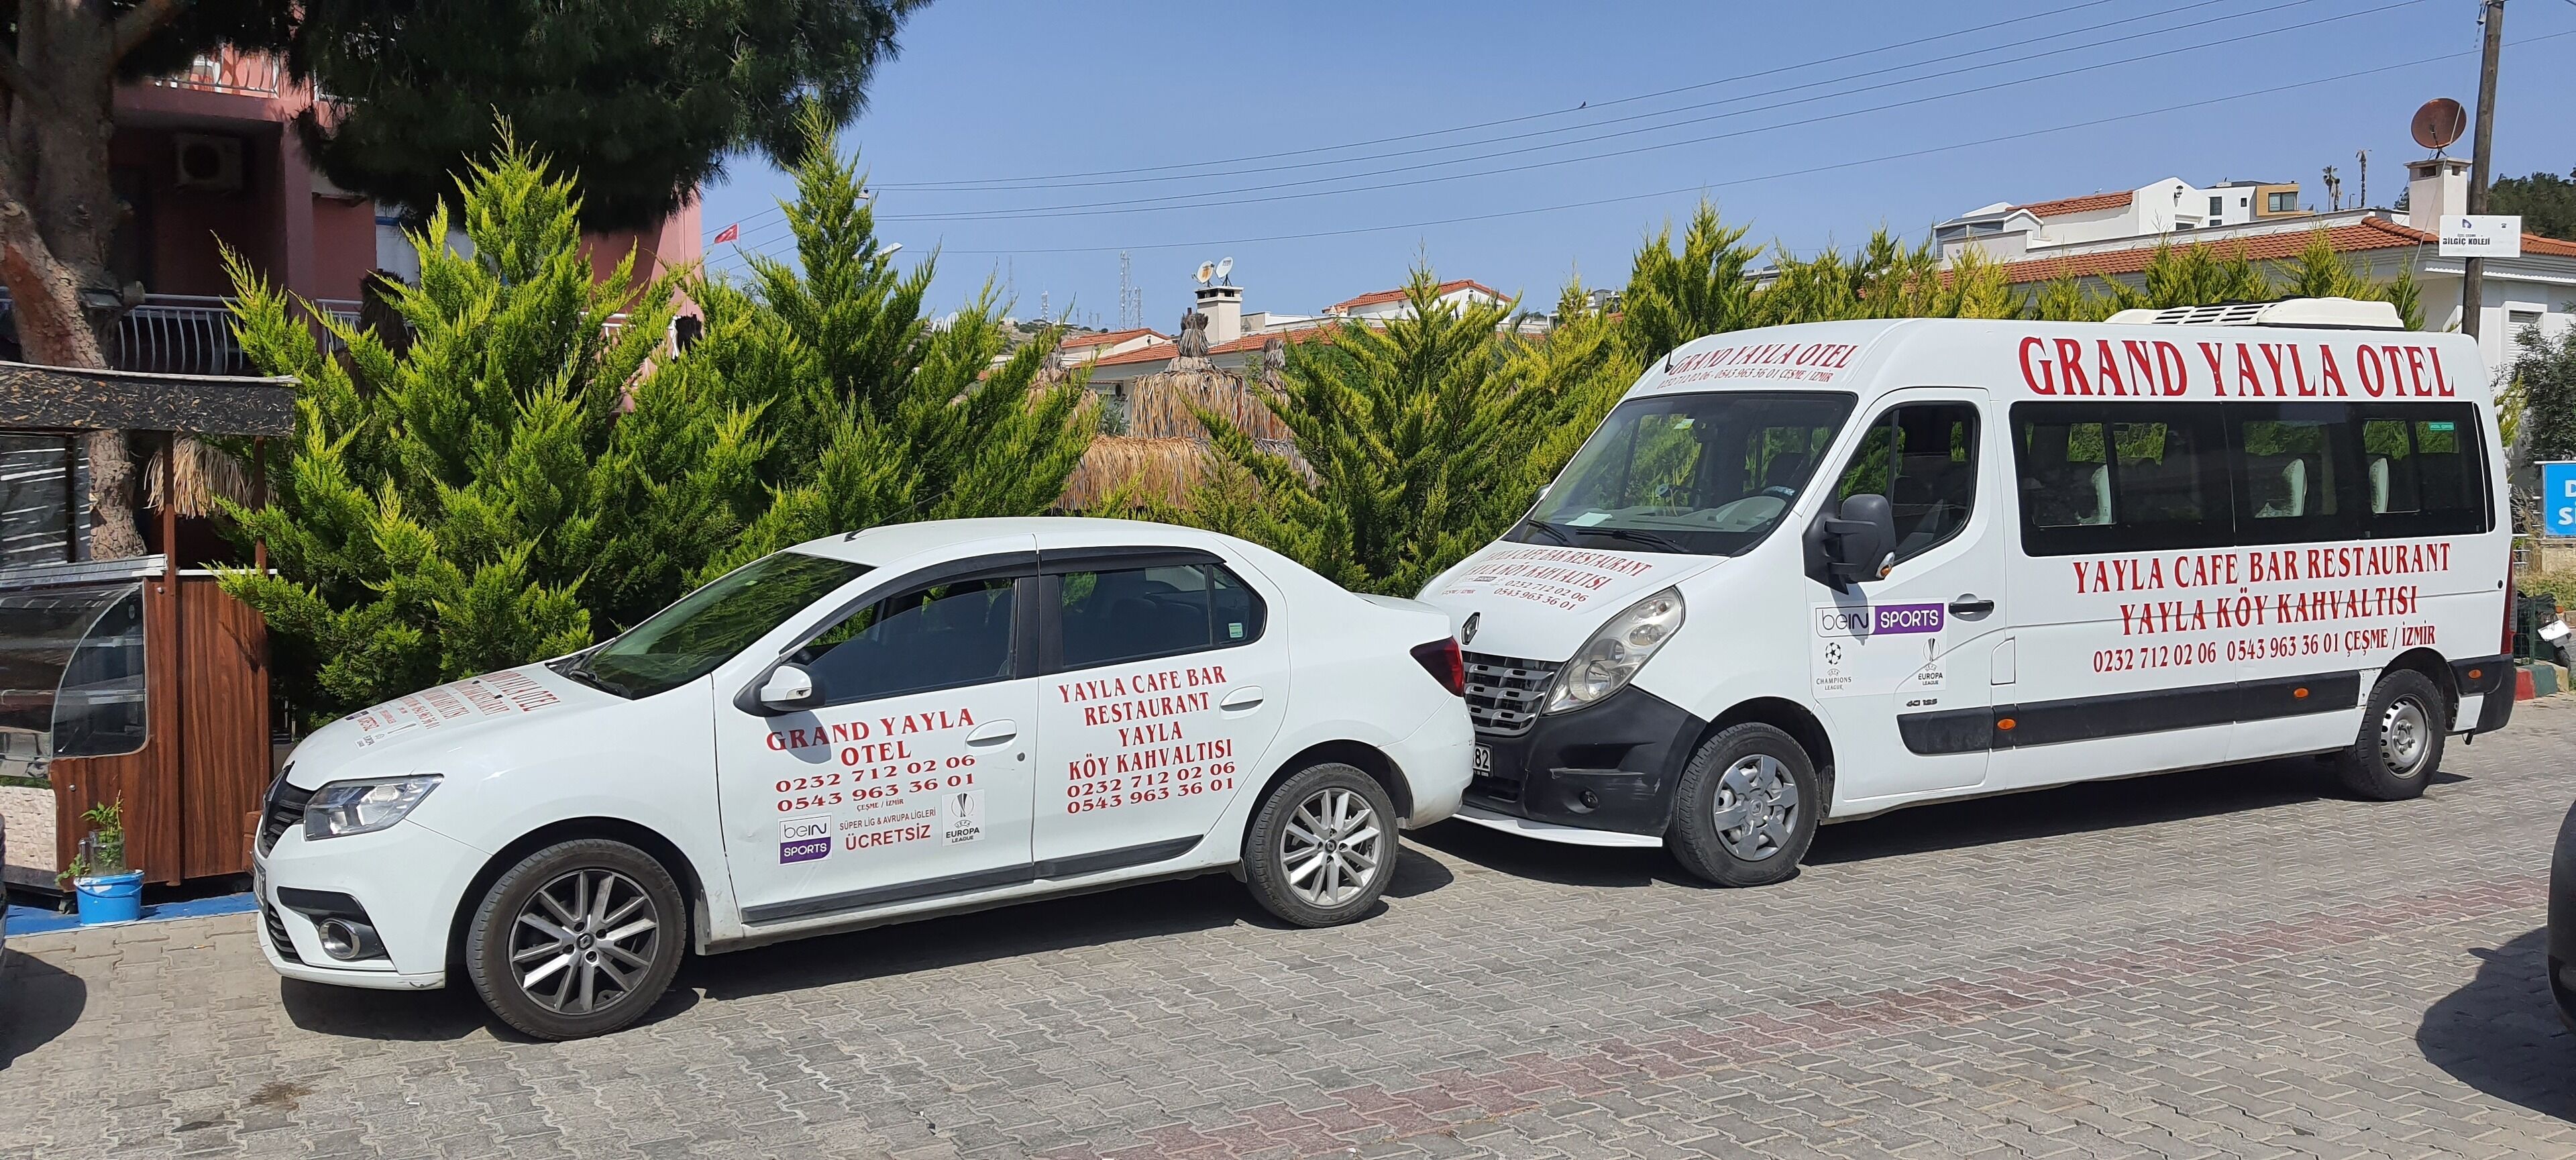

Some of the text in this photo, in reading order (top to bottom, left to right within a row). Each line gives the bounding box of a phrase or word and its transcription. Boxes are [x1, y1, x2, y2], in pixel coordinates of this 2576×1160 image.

[1669, 343, 1858, 376] GRAND YAYLA OTEL
[2019, 337, 2455, 398] GRAND YAYLA OTEL
[1765, 368, 1780, 378] 01
[1562, 551, 1652, 576] RESTAURANT
[2074, 543, 2451, 594] YAYLA CAFE BAR RESTAURANT
[1521, 566, 1613, 590] KAHVALTISI
[1532, 584, 1555, 592] 712
[1554, 588, 1571, 596] 02
[1571, 592, 1589, 602] 06
[1560, 600, 1576, 611] 01
[1880, 610, 1938, 628] SPORTS
[2120, 586, 2418, 635] YAYLA KÖY KAHVALTISI
[2093, 648, 2133, 673] 0232
[2141, 646, 2169, 669] 712
[2174, 644, 2192, 666] 02
[2198, 642, 2216, 664] 06
[2227, 639, 2265, 662] 0543
[2270, 637, 2296, 657] 963
[2302, 634, 2319, 655] 36
[2324, 633, 2339, 653] 01
[2345, 629, 2388, 656] ÇEŞME
[2401, 620, 2435, 647] İZMİR
[1058, 665, 1227, 704] YAYLA CAFE BAR
[1816, 676, 1851, 685] CHAMPIONS
[1918, 672, 1943, 680] EUROPA
[511, 690, 561, 712] OTEL
[1084, 692, 1210, 727] RESTAURANT
[766, 708, 975, 751] GRAND YAYLA
[1119, 721, 1183, 747] YAYLA
[841, 740, 911, 768] OTEL
[1068, 739, 1233, 781] KÖY KAHVALTISI
[1473, 748, 1489, 770] 82
[775, 755, 976, 792] 0232 712 02 06
[1067, 761, 1236, 798] 0232 712 02 06
[777, 773, 974, 812] 0543 963 36 01
[857, 804, 879, 812] ÇEŞME
[885, 798, 904, 806] İZMİR
[1067, 778, 1234, 814] 0543 963 36 01
[840, 806, 936, 831] SÜPER LİG & AVRUPA LİGLERİ
[954, 820, 972, 829] UEFA
[845, 823, 931, 851] ÜCRETSİZ
[946, 827, 980, 839] EUROPA
[952, 835, 974, 843] LEAGUE
[784, 843, 827, 857] SPORTS
